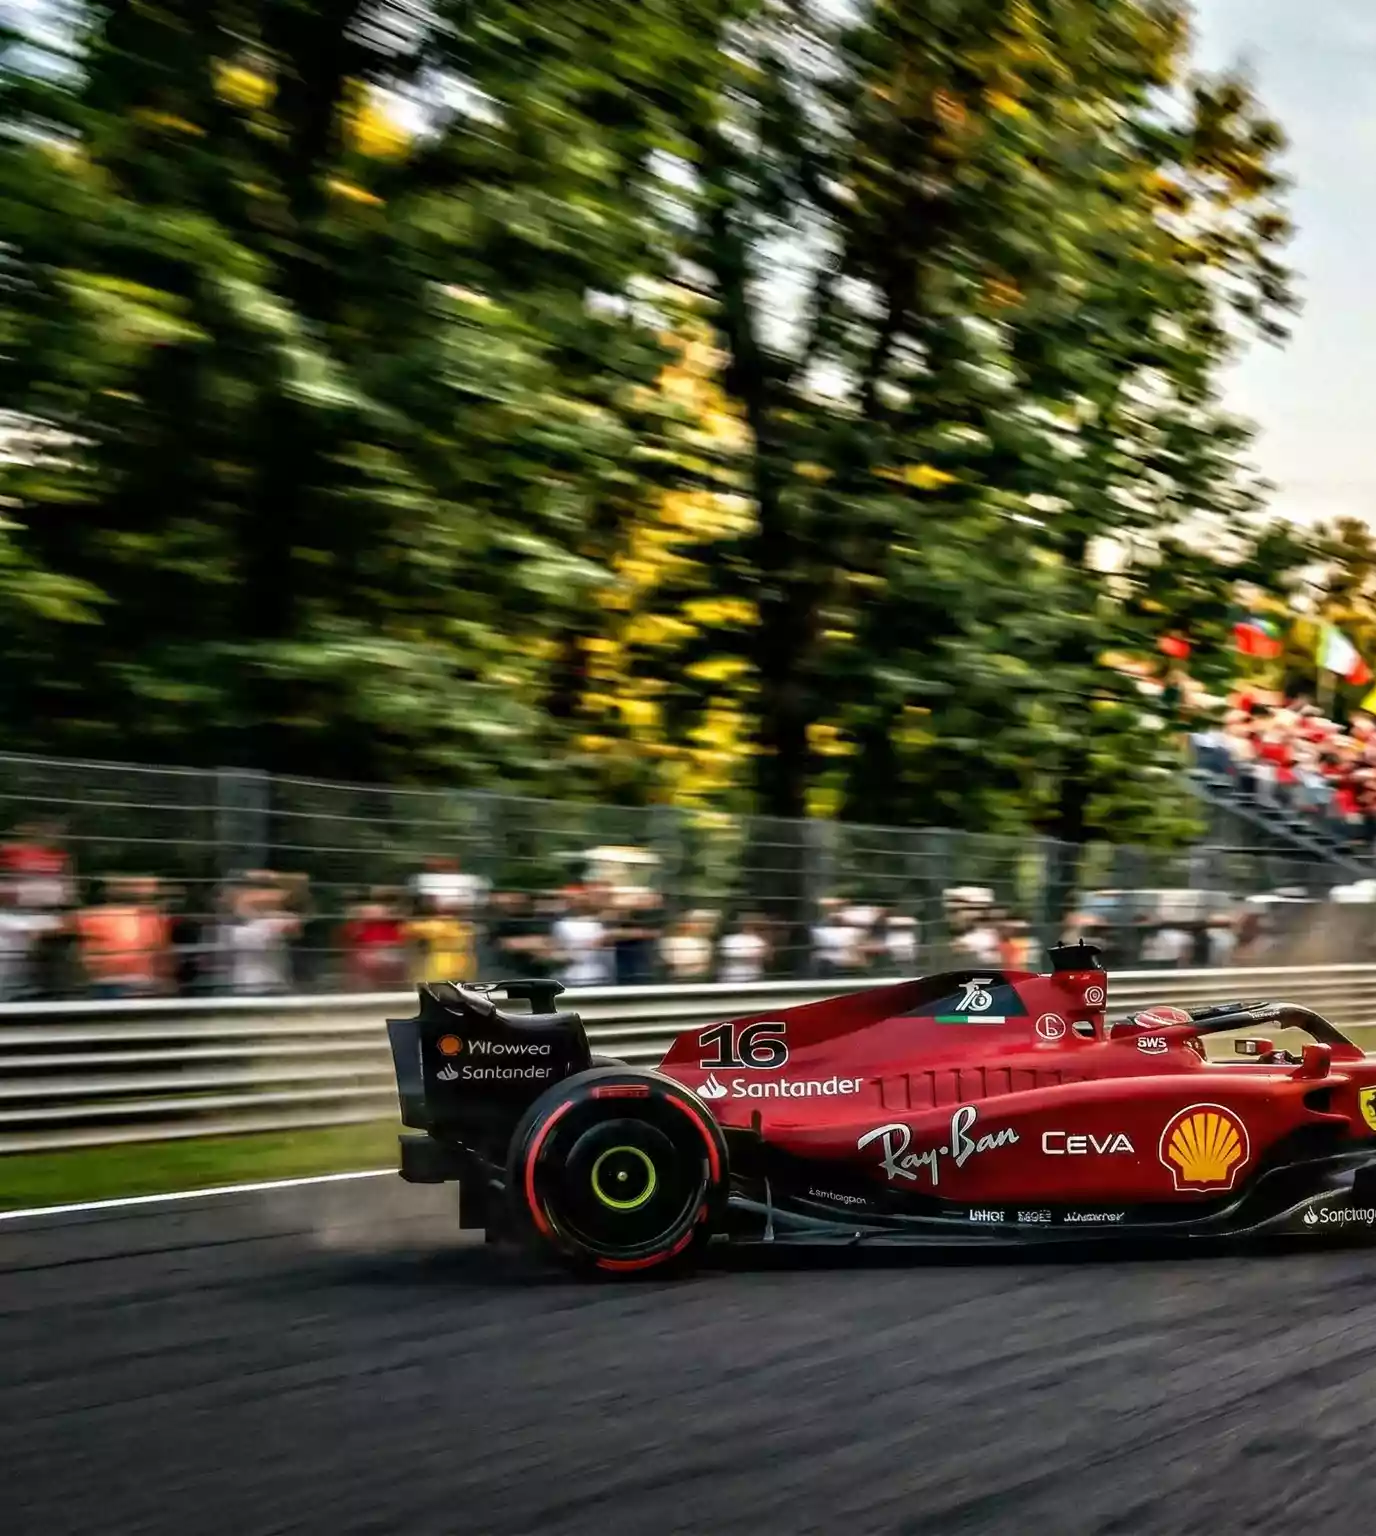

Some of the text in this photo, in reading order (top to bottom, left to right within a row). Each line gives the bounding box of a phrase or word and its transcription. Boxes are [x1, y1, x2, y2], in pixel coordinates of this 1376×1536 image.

[699, 1021, 789, 1070] 16
[462, 1065, 553, 1080] Santander
[731, 1076, 864, 1098] Santander
[1041, 1131, 1135, 1155] CEVA
